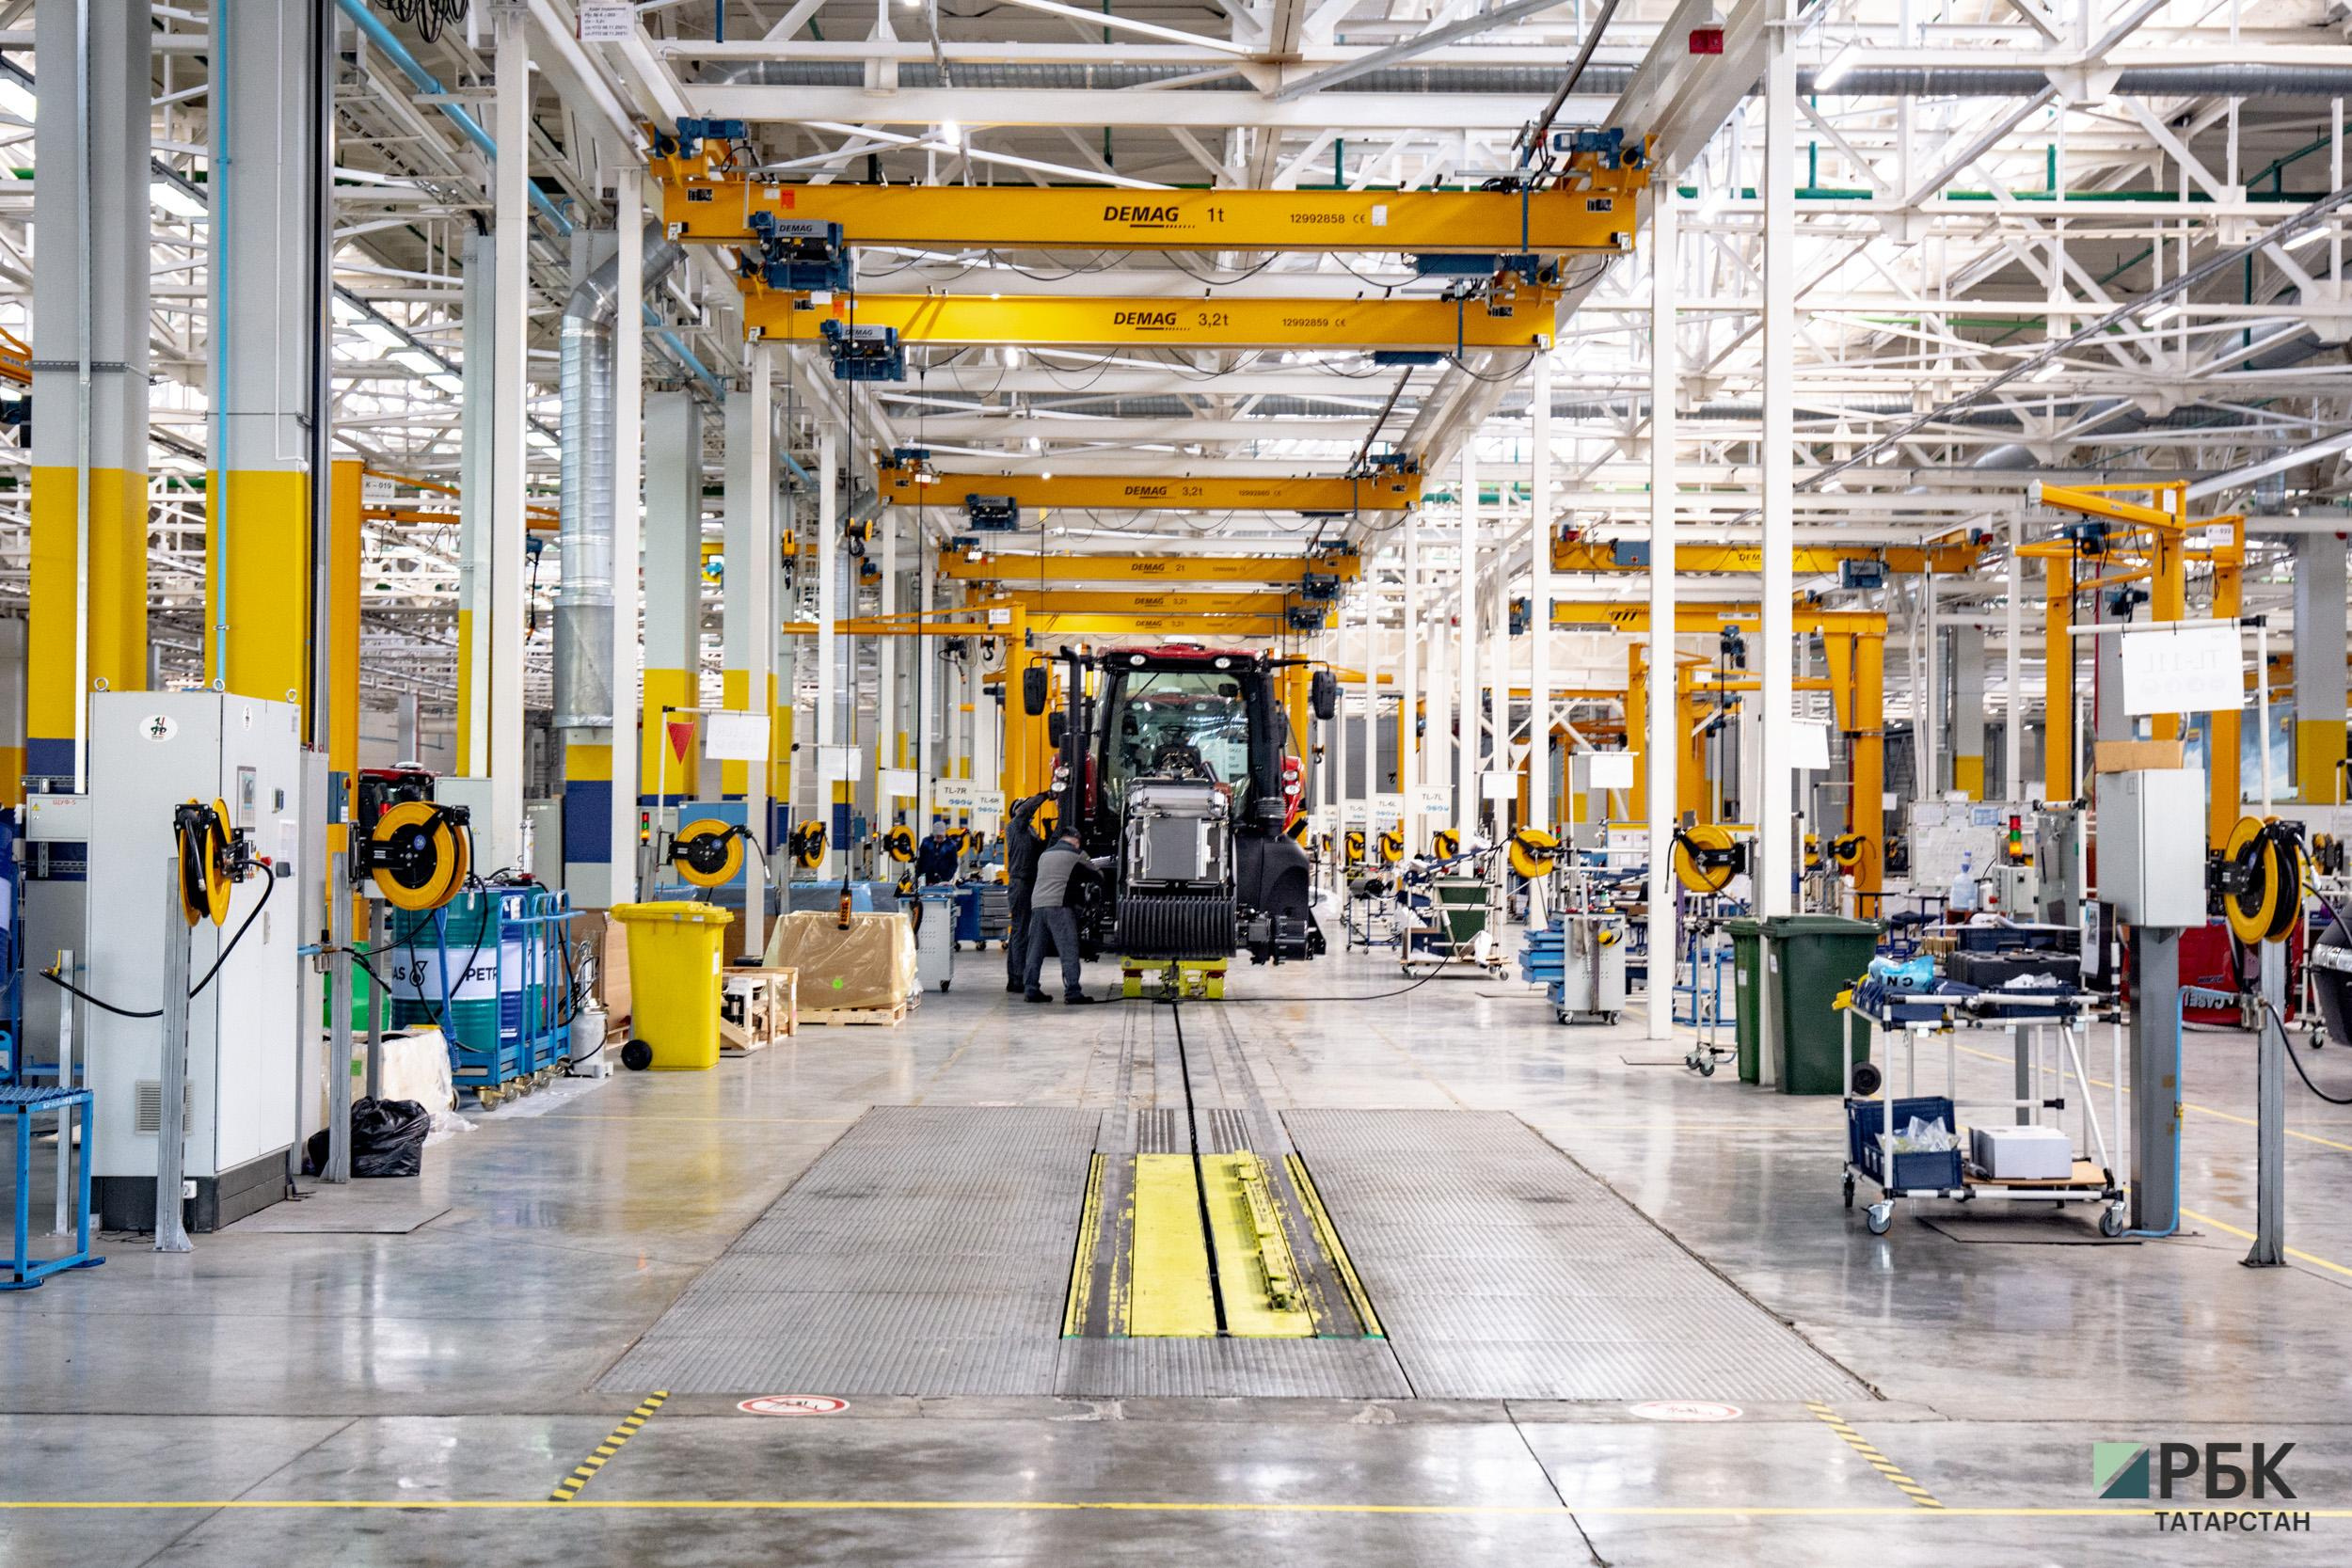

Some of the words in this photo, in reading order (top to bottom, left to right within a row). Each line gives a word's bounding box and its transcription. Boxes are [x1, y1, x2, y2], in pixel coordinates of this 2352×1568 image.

[1103, 206, 1180, 223] DEMAG
[1207, 207, 1225, 223] 1t
[1290, 214, 1345, 224] 12992858
[778, 224, 813, 233] DEMAG
[1113, 311, 1177, 326] DEMAG
[1281, 318, 1328, 327] 12992859
[1124, 485, 1168, 496] DEMAG
[1131, 563, 1166, 572] DEMAG
